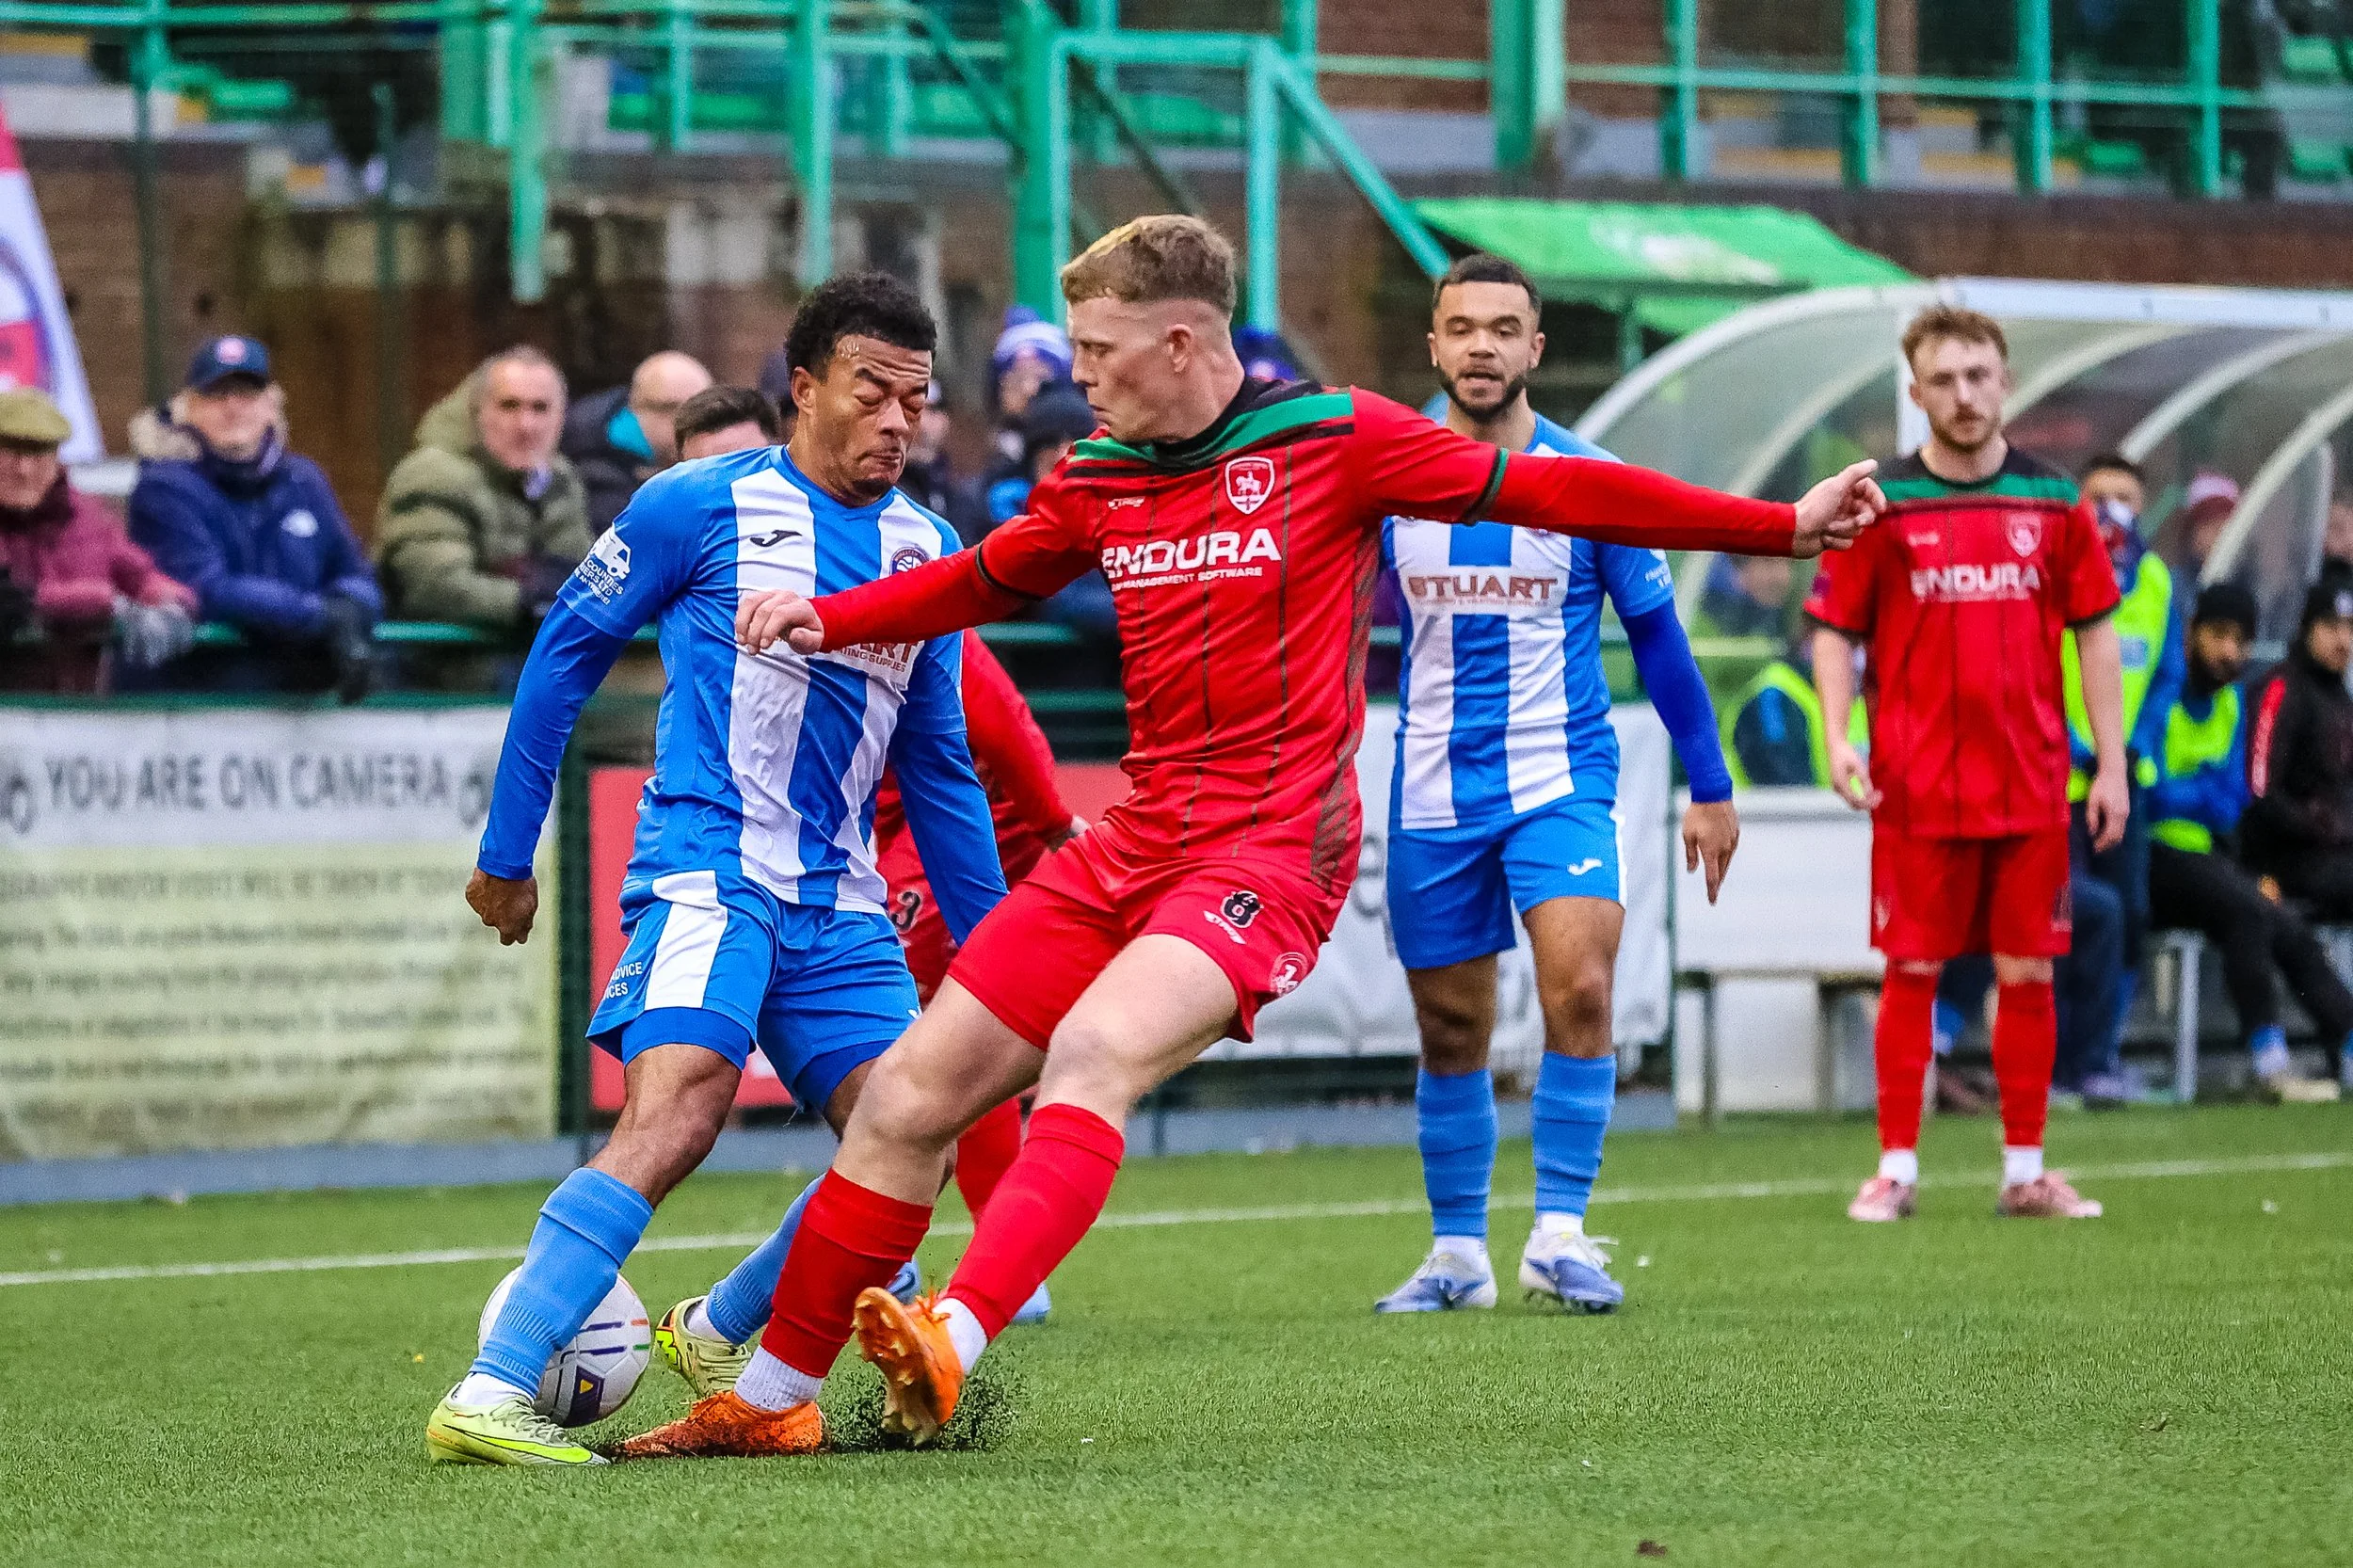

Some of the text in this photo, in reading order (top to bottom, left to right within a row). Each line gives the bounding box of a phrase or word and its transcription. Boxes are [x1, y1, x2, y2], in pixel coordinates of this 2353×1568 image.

[1101, 528, 1282, 579] ENDURA
[586, 559, 624, 595] COUNTIES
[1197, 567, 1263, 582] SOFTWARE
[1408, 574, 1559, 600] STUART
[598, 579, 614, 597] LTD
[868, 654, 906, 673] SUPPLIES
[44, 754, 449, 809] YOU ARE ON CAMERA
